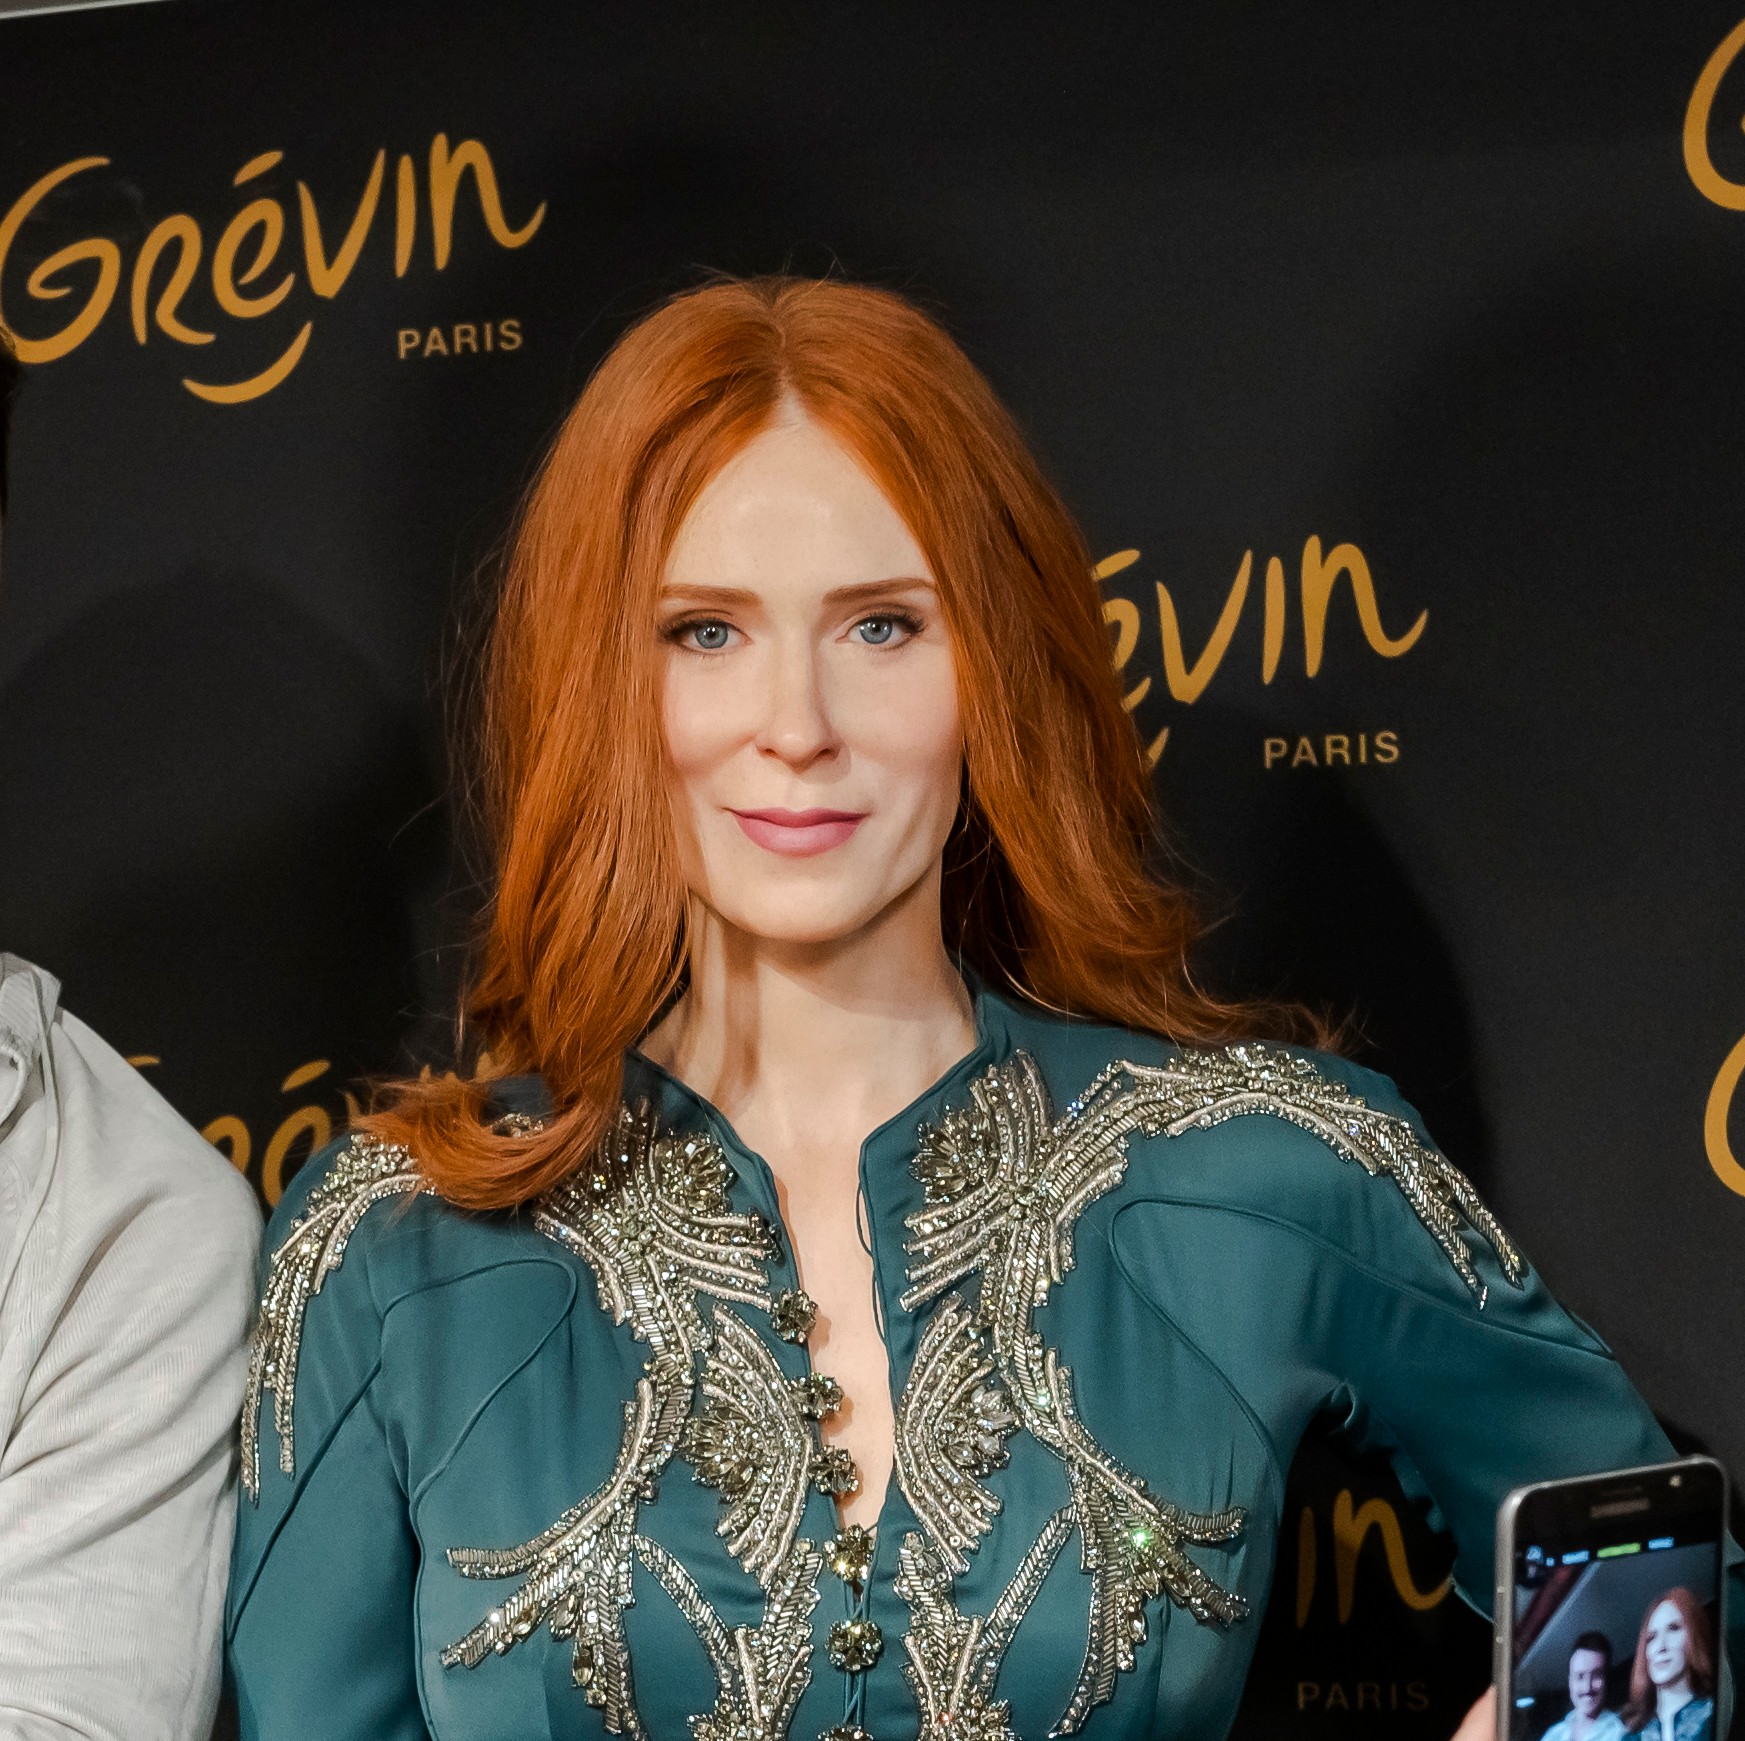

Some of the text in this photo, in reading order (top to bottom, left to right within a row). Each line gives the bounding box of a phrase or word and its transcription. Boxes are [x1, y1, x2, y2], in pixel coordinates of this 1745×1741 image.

[397, 319, 524, 360] PARIS
[1264, 730, 1400, 770] PARIS
[1295, 1681, 1431, 1713] PARIS
